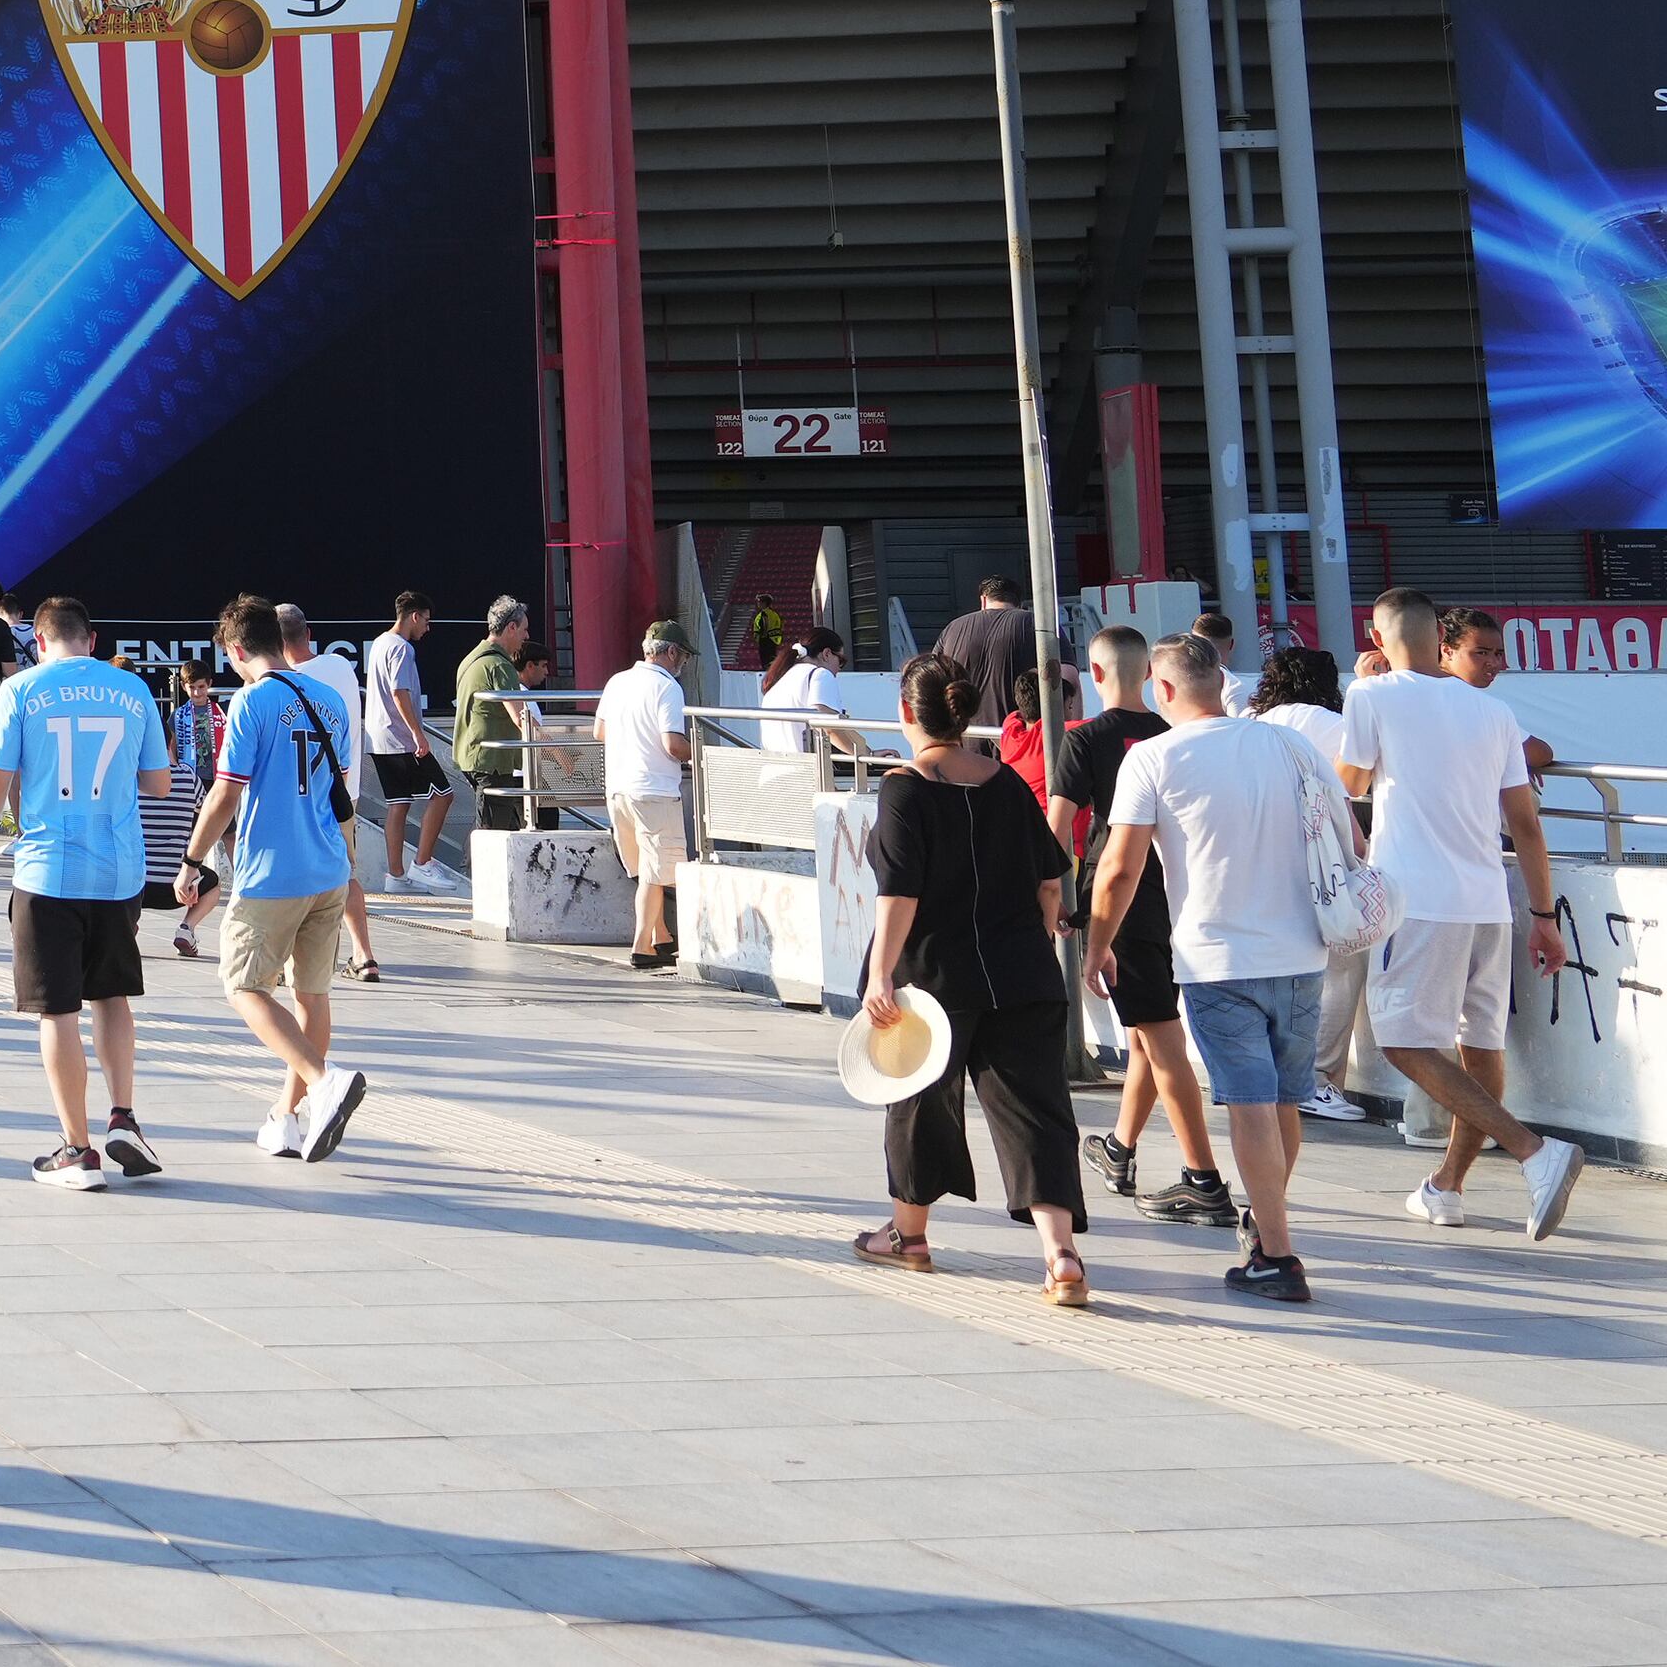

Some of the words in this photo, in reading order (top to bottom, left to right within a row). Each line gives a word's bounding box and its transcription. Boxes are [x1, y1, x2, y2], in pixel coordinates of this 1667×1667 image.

[834, 412, 852, 420] Gate
[773, 414, 832, 454] 22
[862, 439, 886, 453] 121
[717, 442, 743, 456] 122
[27, 689, 55, 715] DE
[59, 685, 147, 718] BRUYNE
[280, 705, 297, 726] DE
[46, 716, 125, 800] 17
[290, 728, 334, 796] 17
